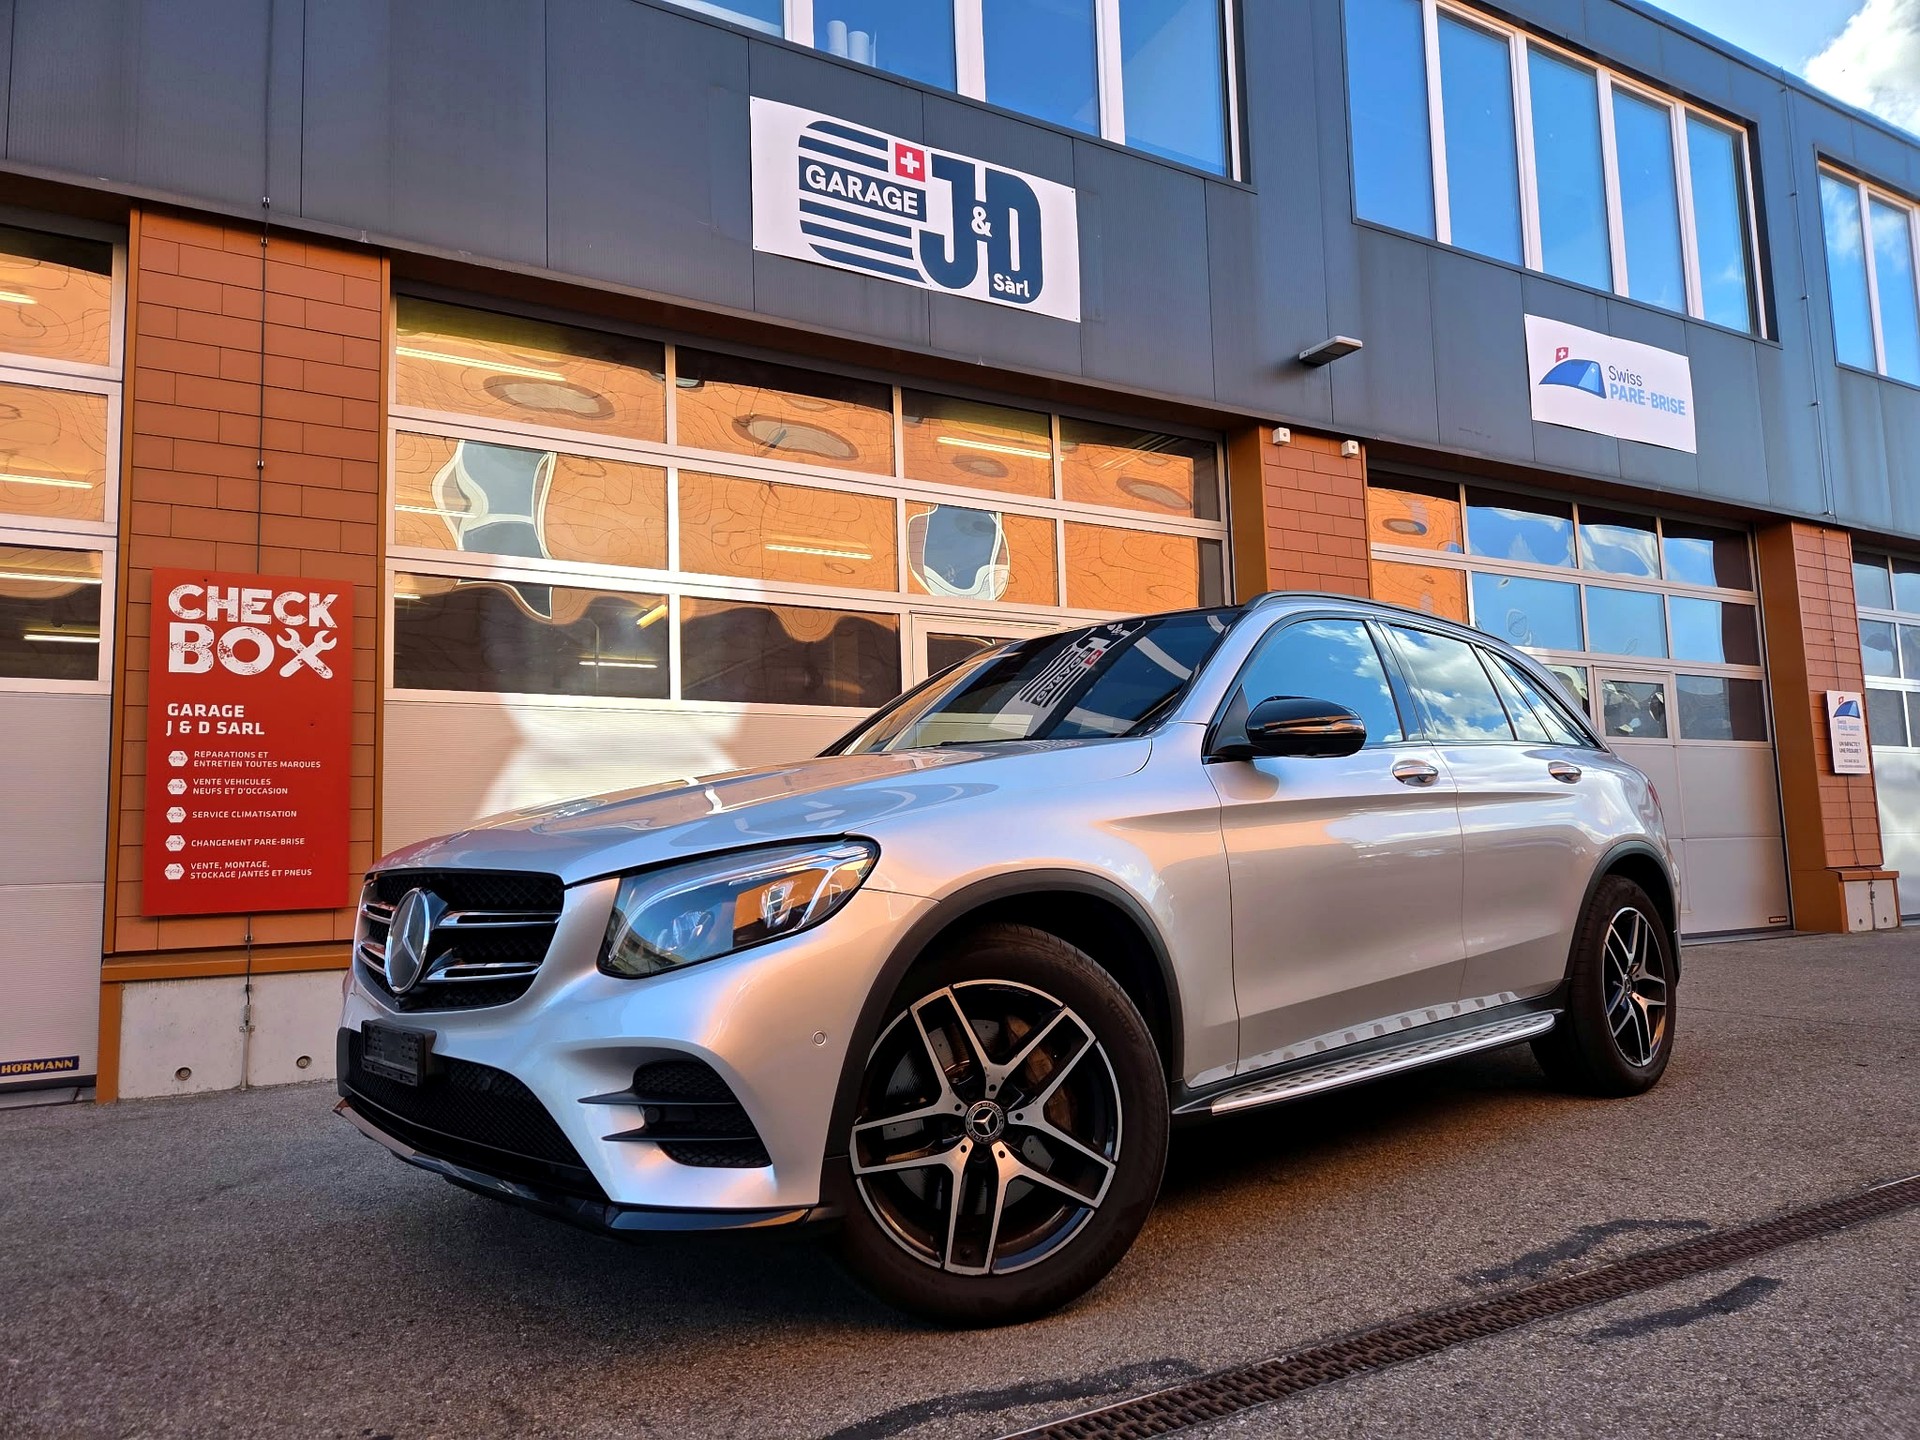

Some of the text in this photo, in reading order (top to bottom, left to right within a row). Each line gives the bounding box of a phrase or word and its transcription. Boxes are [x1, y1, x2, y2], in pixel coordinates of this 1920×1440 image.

[805, 163, 919, 216] GARAGE
[918, 152, 1045, 305] J & D
[992, 273, 1031, 299] Sàrl
[1608, 365, 1643, 387] Swiss
[1609, 383, 1686, 416] PARE-BRISE
[168, 583, 339, 629] CHECK
[167, 703, 245, 718] GARAGE
[165, 720, 265, 737] J & D SARL
[194, 750, 269, 759] REPARATIONS ET
[193, 760, 321, 769] ENTRETIEN TOUTES MARQUES
[193, 778, 271, 786] VENTE VEHICULES
[192, 787, 288, 795] NEUFS ET D'OCCASION
[192, 810, 297, 819] SERVICE CLIMATISATION
[191, 837, 305, 847] CHANGEMENT PARE-BRISE
[190, 861, 222, 870] VENTE,
[190, 868, 313, 880] STOCKAGE JANTES ET PNEUS
